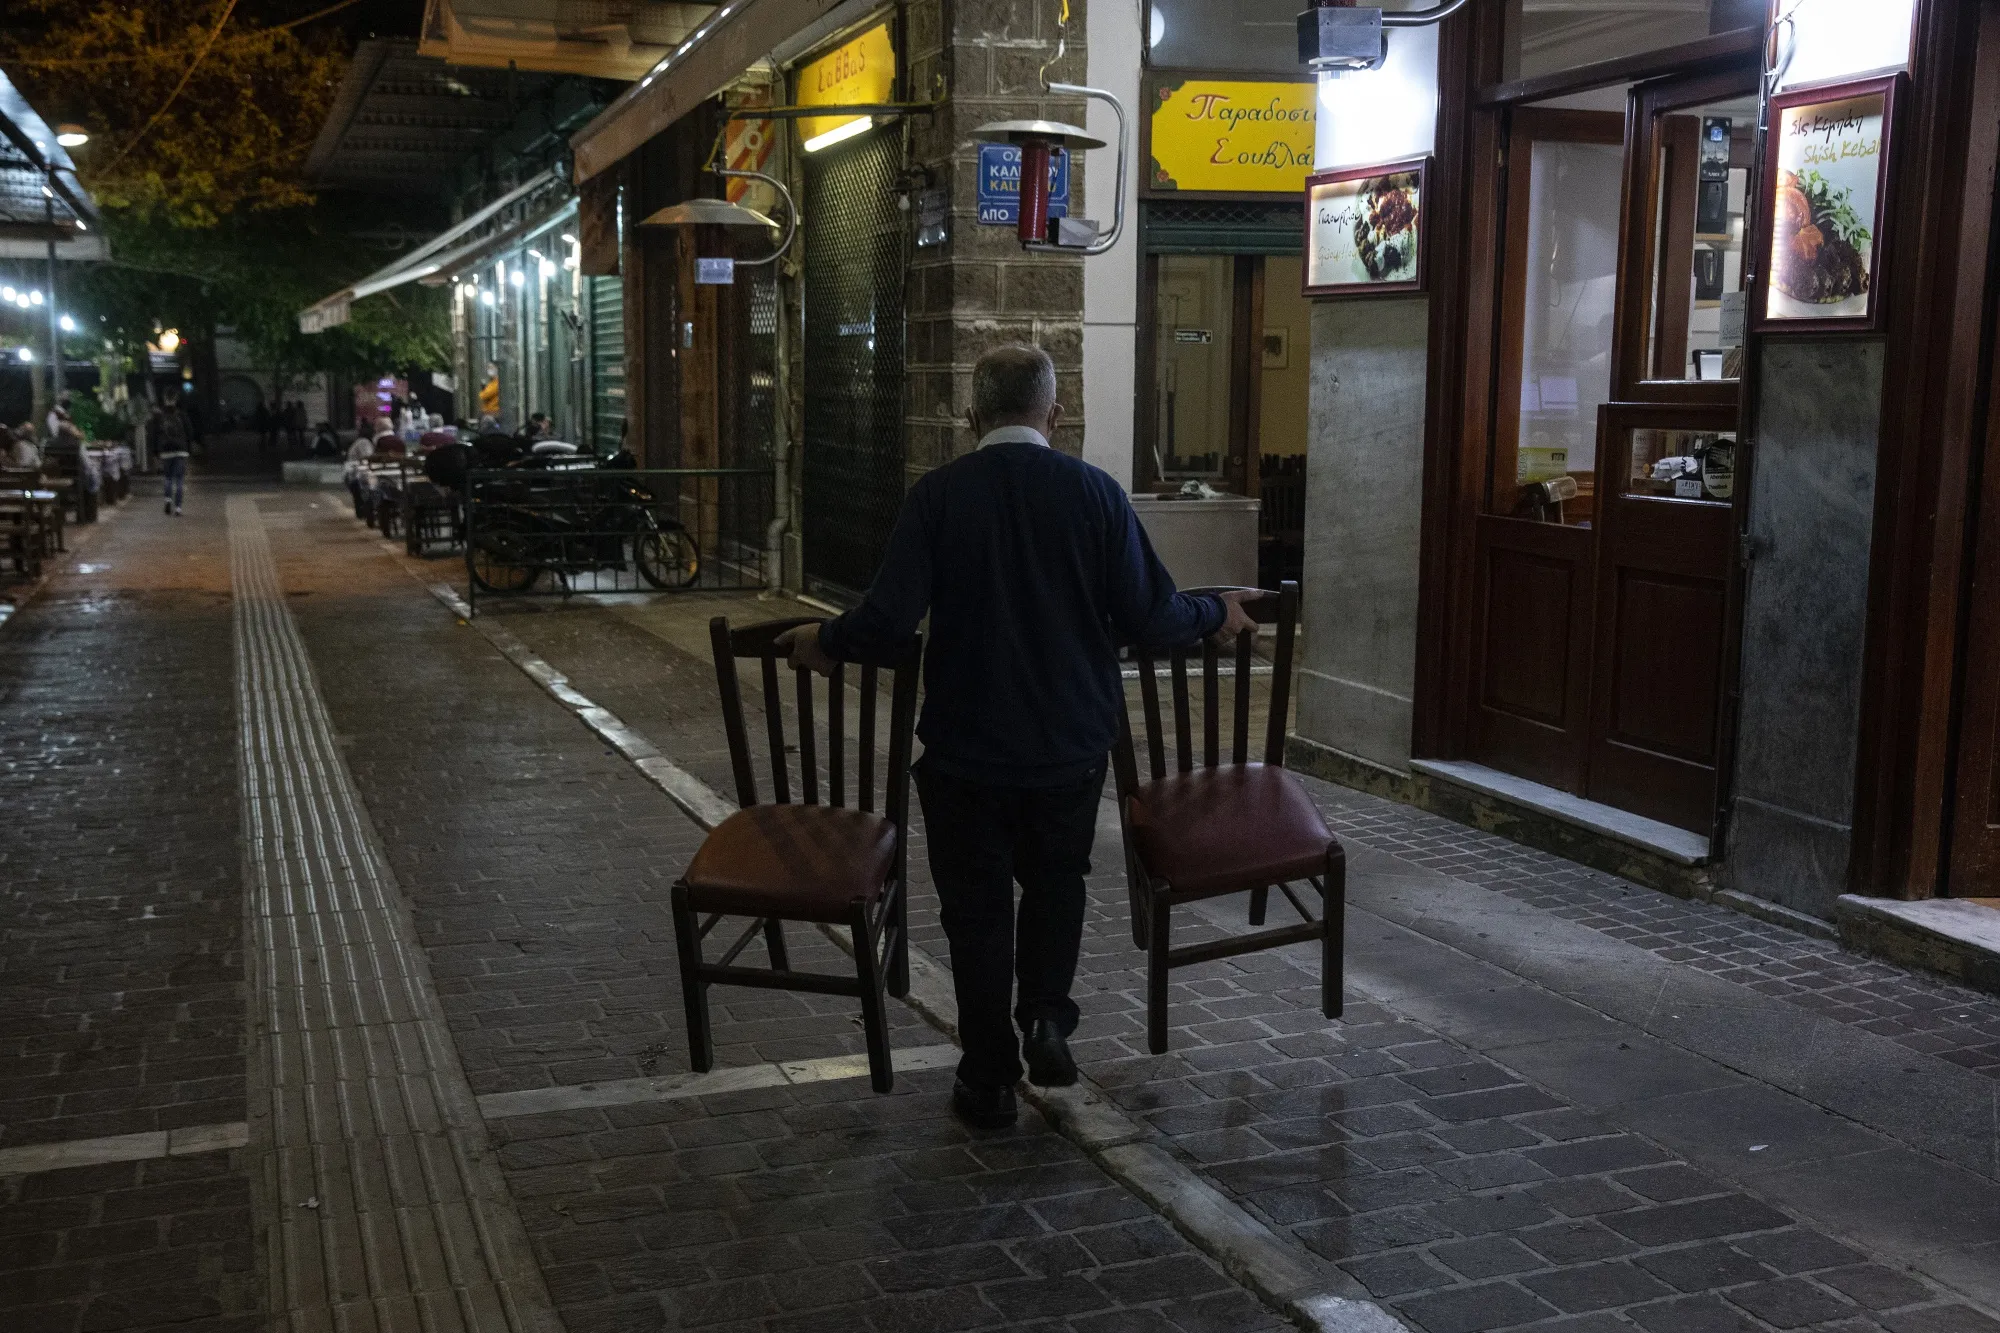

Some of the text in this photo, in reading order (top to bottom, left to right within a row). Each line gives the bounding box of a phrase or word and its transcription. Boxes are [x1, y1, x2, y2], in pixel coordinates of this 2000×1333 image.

[1186, 94, 1317, 132] Παραδοσι
[1210, 138, 1315, 169] Σουβλά
[981, 209, 1009, 221] ΑΠΟ
